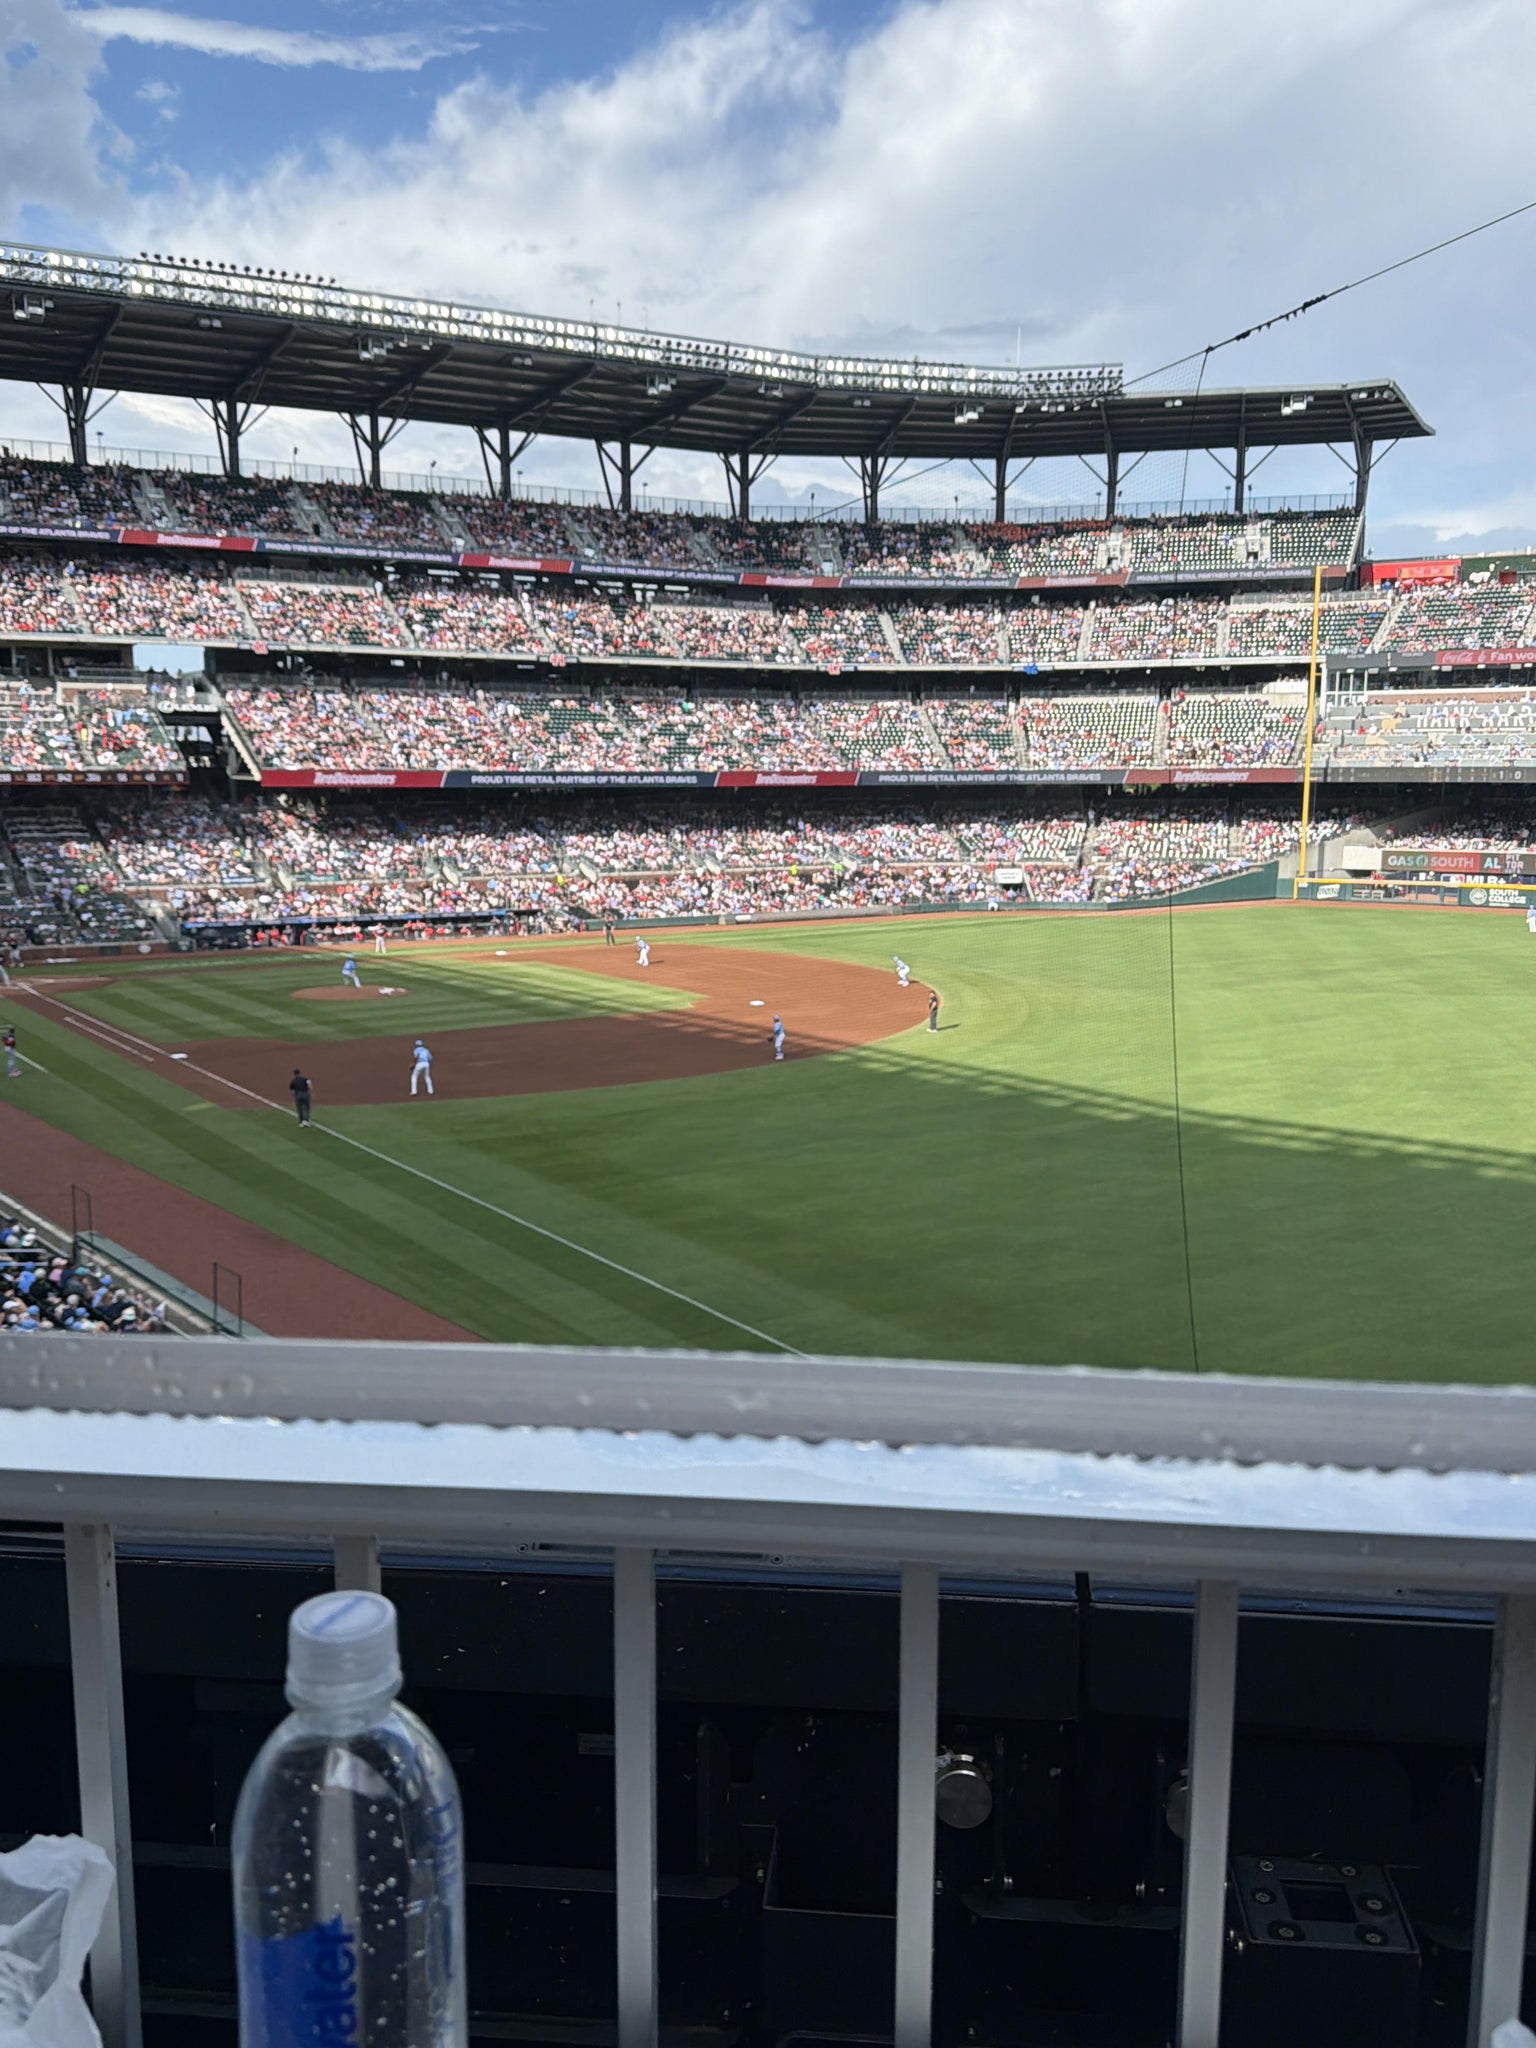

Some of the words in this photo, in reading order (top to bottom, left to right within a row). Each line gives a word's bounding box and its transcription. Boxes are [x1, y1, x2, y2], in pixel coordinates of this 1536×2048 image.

[1491, 652, 1513, 662] Fan
[471, 775, 502, 784] PROUD
[504, 775, 523, 784] TIRE
[525, 775, 555, 784] RETAIL
[556, 775, 596, 784] PARTNER
[597, 775, 608, 784] OF
[610, 775, 626, 784] THE
[627, 775, 664, 784] ATLANTA
[666, 775, 698, 784] BRAVES
[928, 774, 956, 782] RETAIL
[957, 774, 995, 782] PARTNER
[1388, 855, 1414, 866] GAS
[1430, 856, 1474, 868] SOUTH
[1483, 857, 1501, 869] AL
[1505, 861, 1524, 869] TOR
[1488, 896, 1527, 904] COLLEGE
